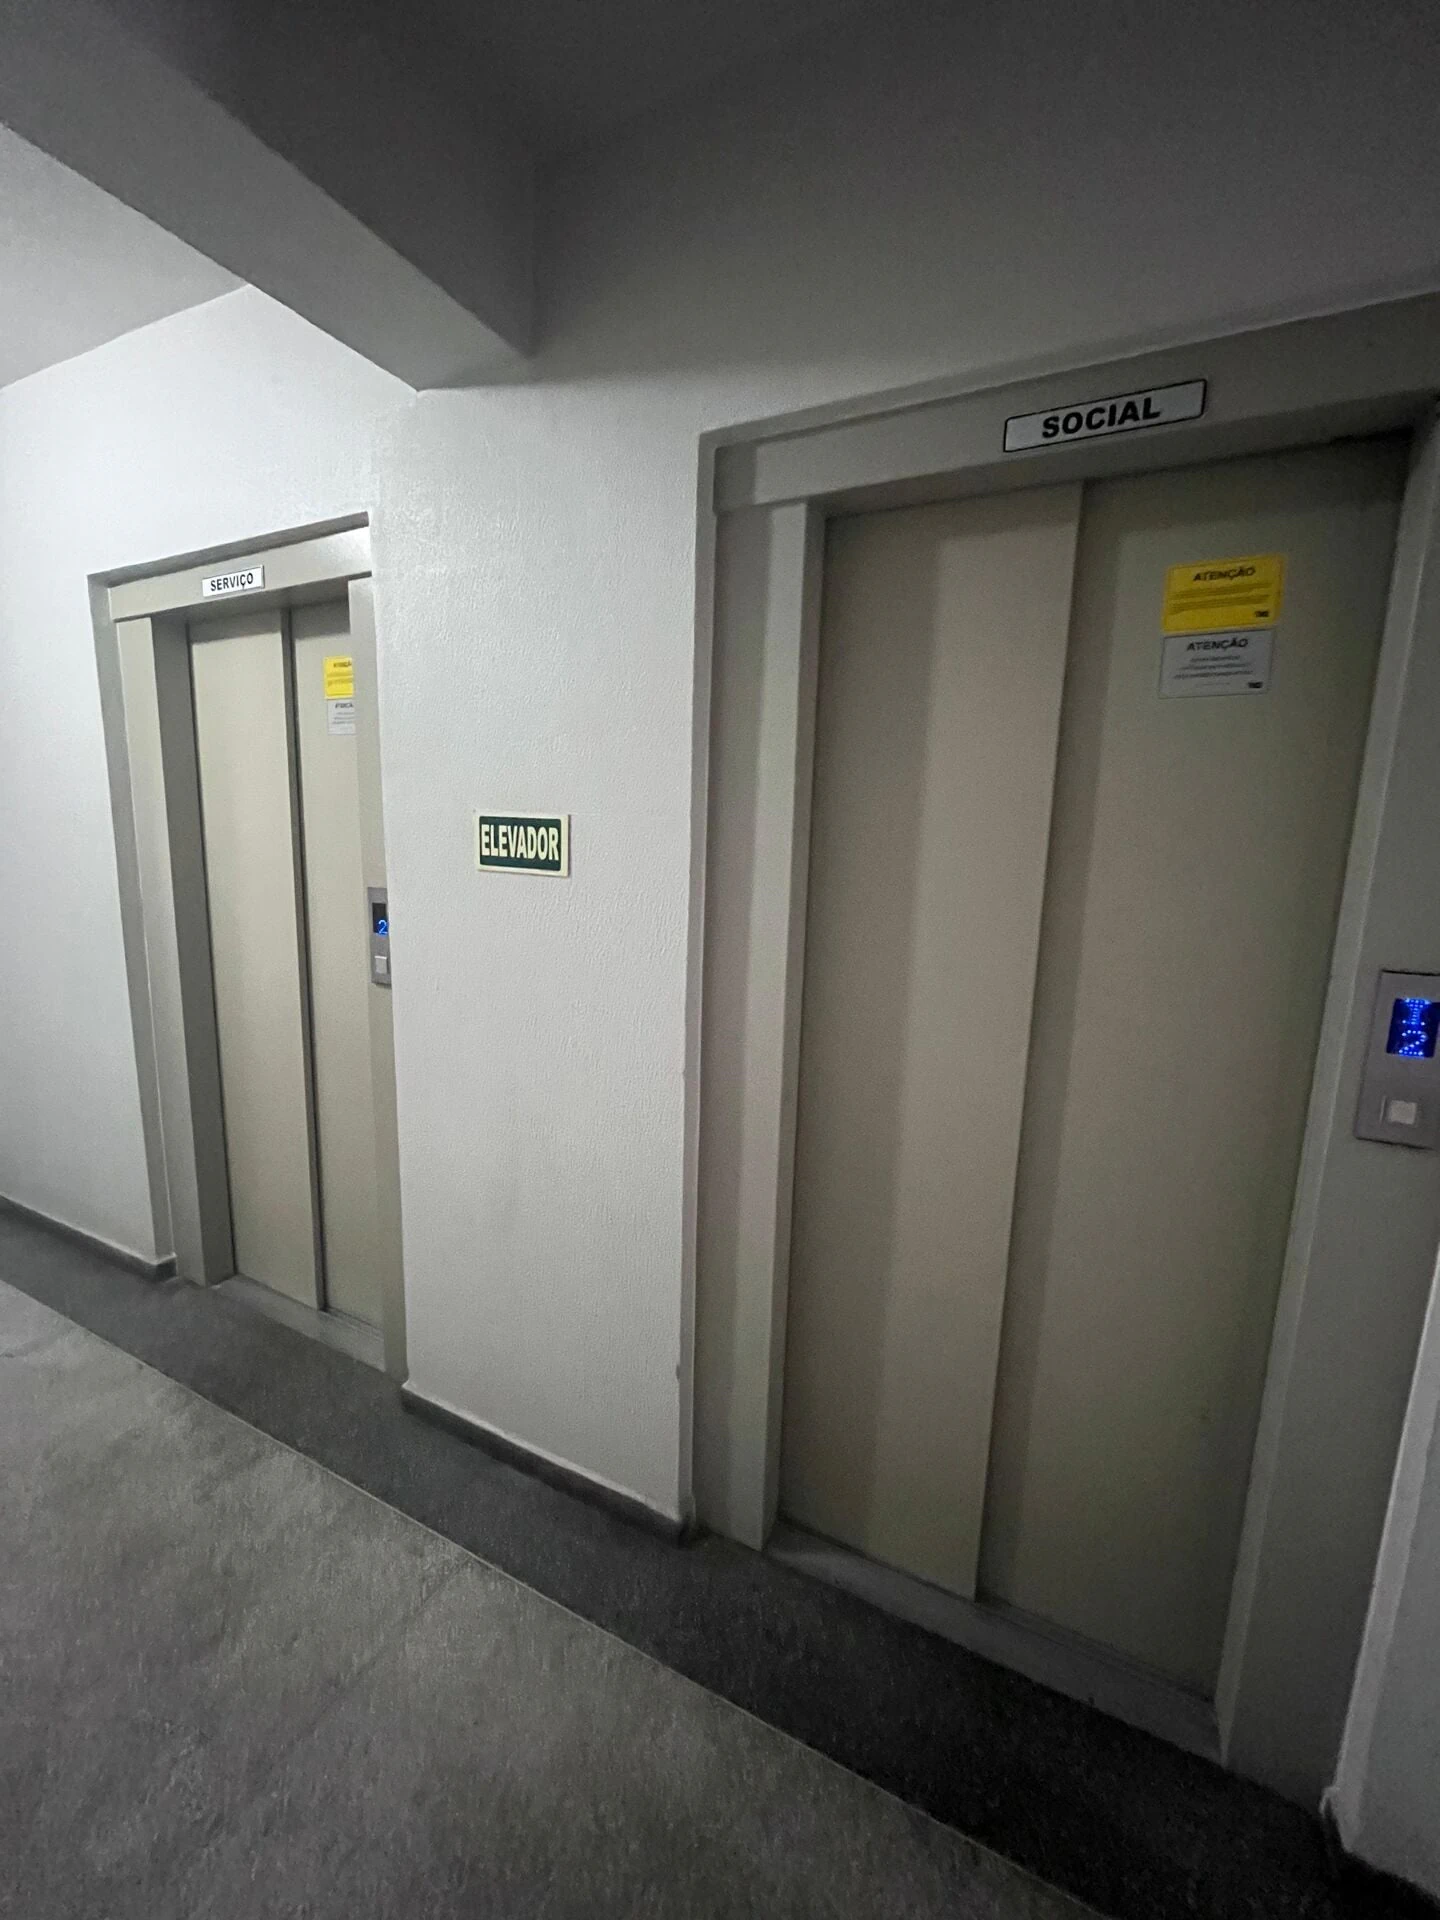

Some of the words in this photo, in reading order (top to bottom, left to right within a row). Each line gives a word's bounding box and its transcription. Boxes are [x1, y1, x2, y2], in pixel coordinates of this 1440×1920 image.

[1042, 397, 1161, 439] SOCIAL
[210, 572, 254, 591] SERVIÇO
[1193, 565, 1256, 581] ATENÇÃO
[1187, 637, 1248, 651] ATENÇÃO
[481, 823, 560, 861] ELEVADOR
[378, 919, 388, 934] 2
[1398, 1029, 1428, 1057] 2
